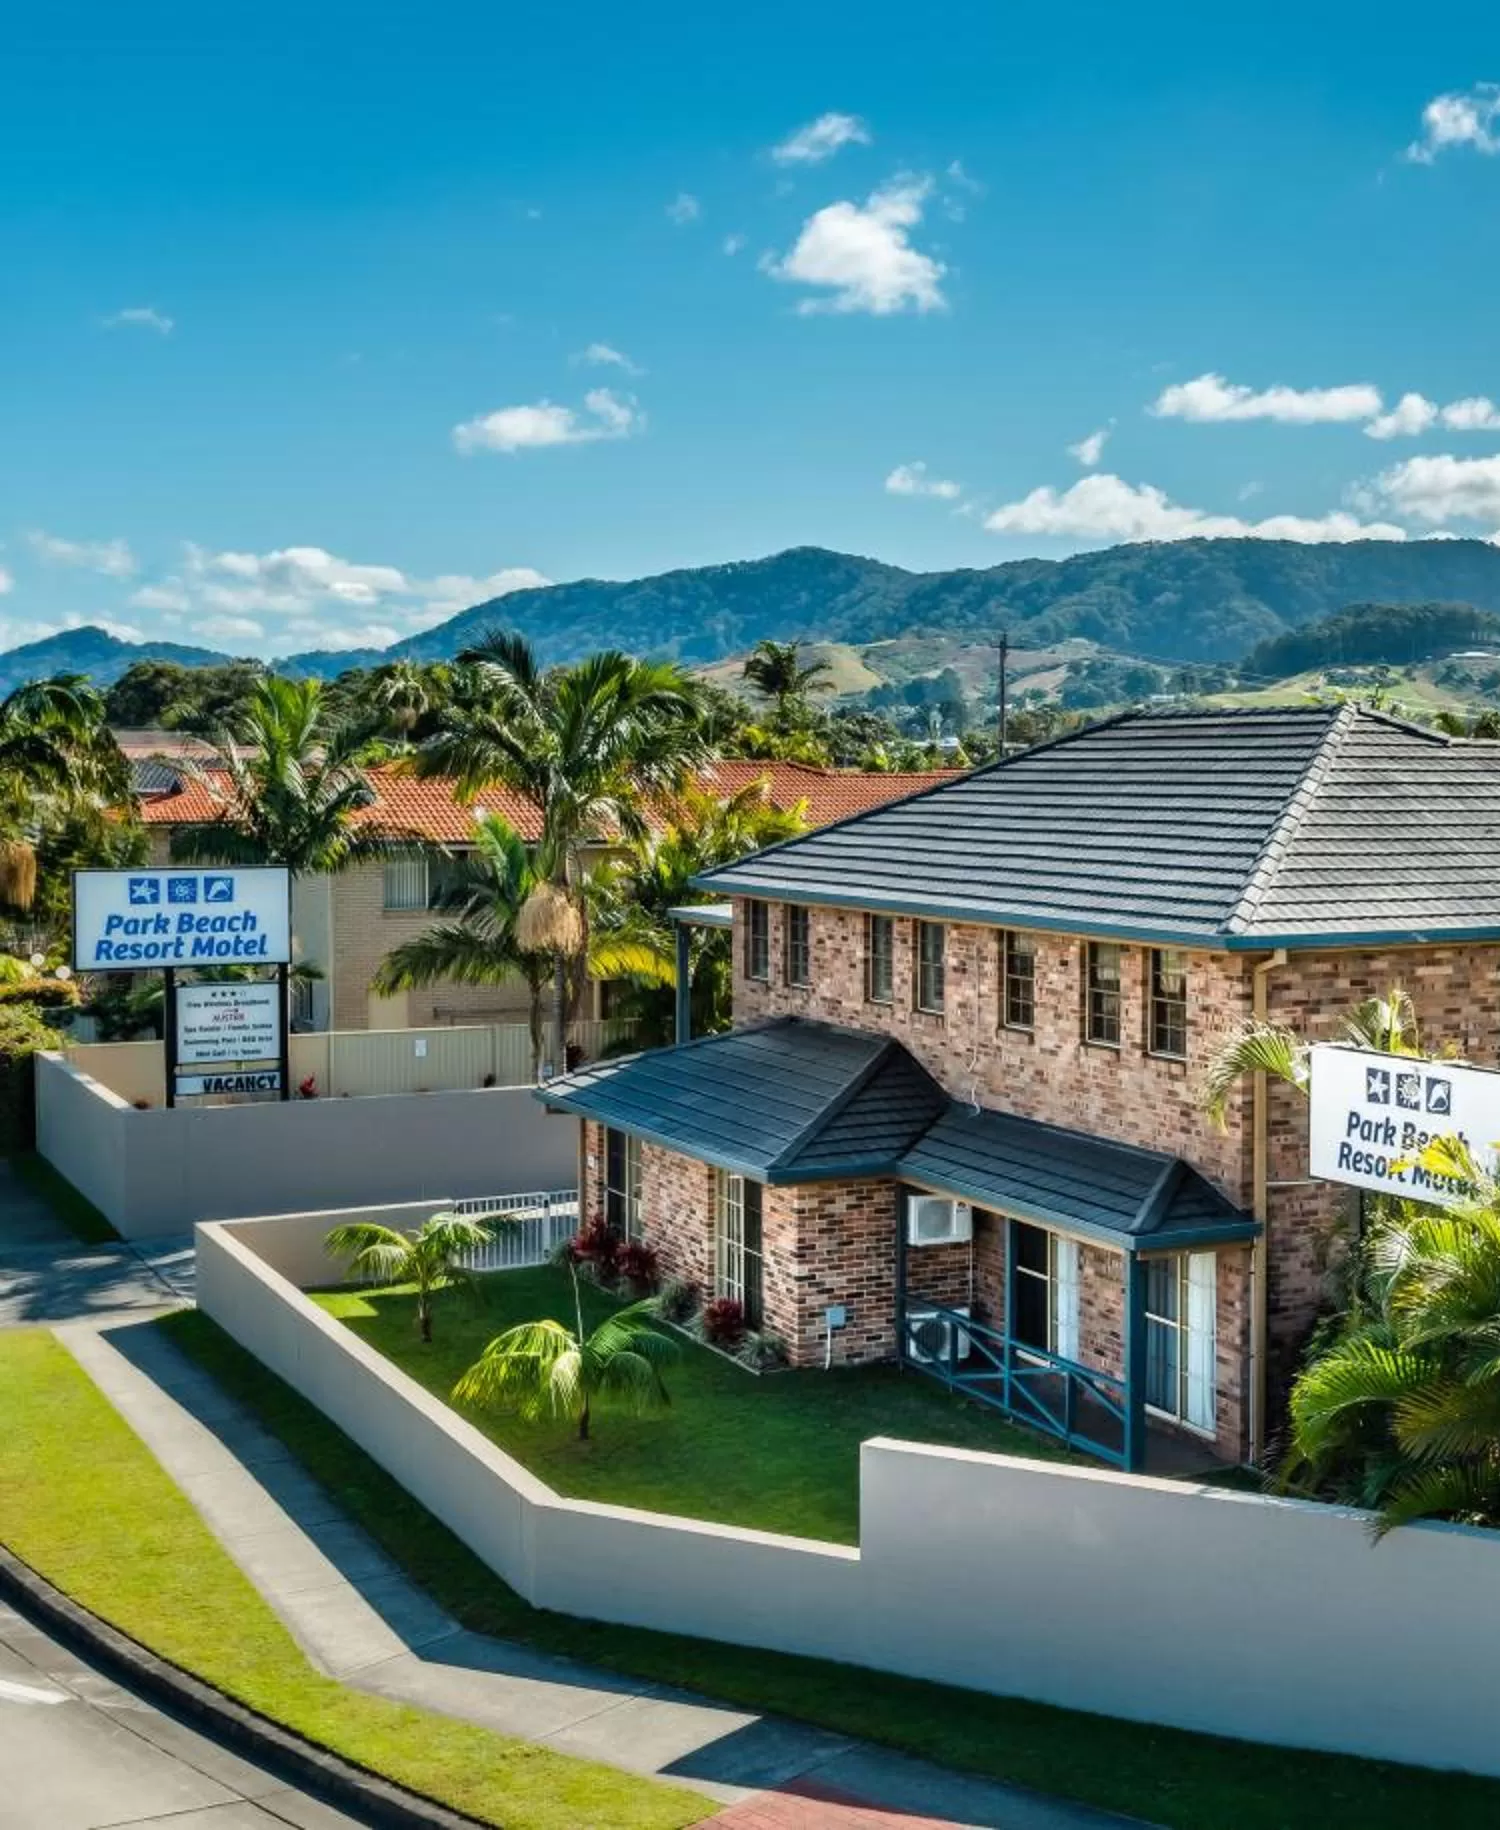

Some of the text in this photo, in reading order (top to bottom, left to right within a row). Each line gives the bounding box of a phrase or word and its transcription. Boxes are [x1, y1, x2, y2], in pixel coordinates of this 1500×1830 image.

[105, 910, 257, 936] Park Beach
[95, 933, 267, 961] Resort Motel
[203, 1074, 277, 1093] VACANCY
[1346, 1110, 1397, 1147] Park
